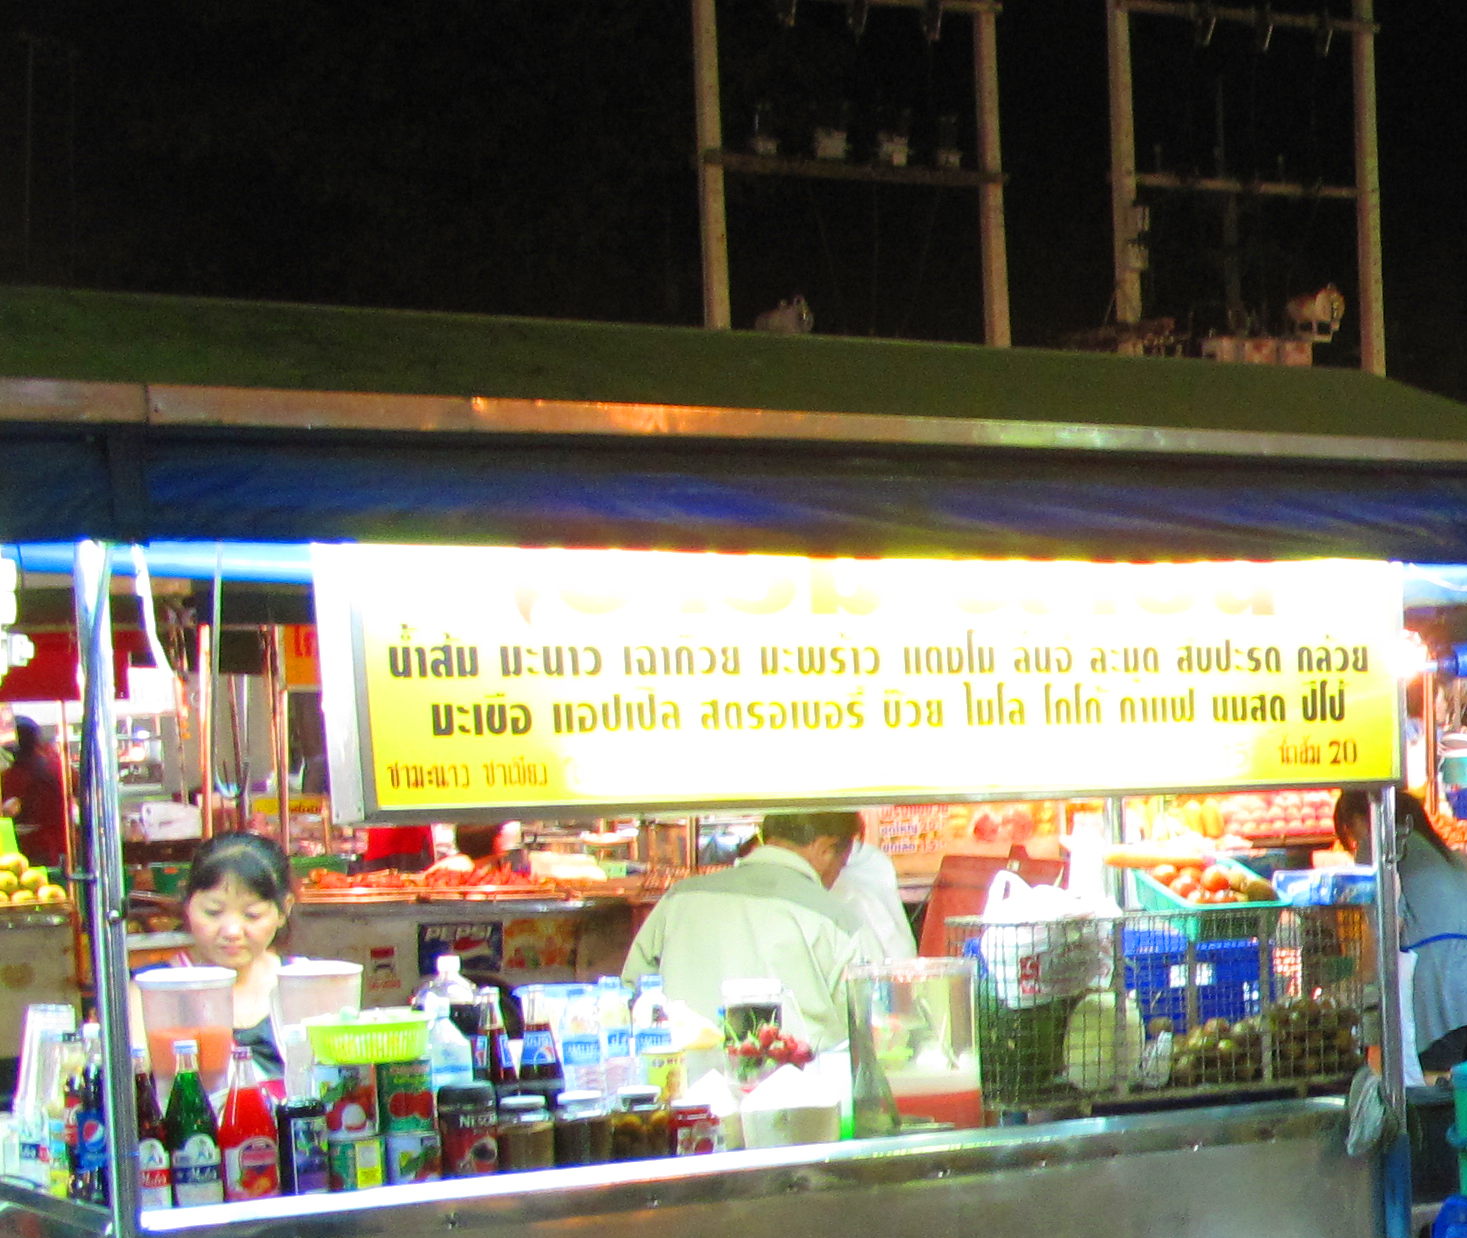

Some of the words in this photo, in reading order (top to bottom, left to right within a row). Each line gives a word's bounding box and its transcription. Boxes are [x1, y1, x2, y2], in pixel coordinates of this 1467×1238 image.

[388, 623, 480, 678] น้ำส้ม
[500, 645, 602, 677] มะนาว
[623, 634, 741, 676] เฉากวย
[760, 631, 881, 675] มะพร้าว
[904, 629, 995, 675] แตงโม
[1177, 637, 1281, 673] สบปะรด
[1297, 634, 1369, 673] กล้วย
[963, 681, 1026, 726] ไมโล
[1044, 681, 1103, 724] โกโก้
[1120, 687, 1195, 724] กาแฟ
[1213, 693, 1287, 723] นมสด
[1329, 739, 1358, 766] 20
[387, 760, 471, 790] ชามะนาว
[483, 755, 549, 788] ชาเขียว
[424, 922, 492, 942] PEPSI
